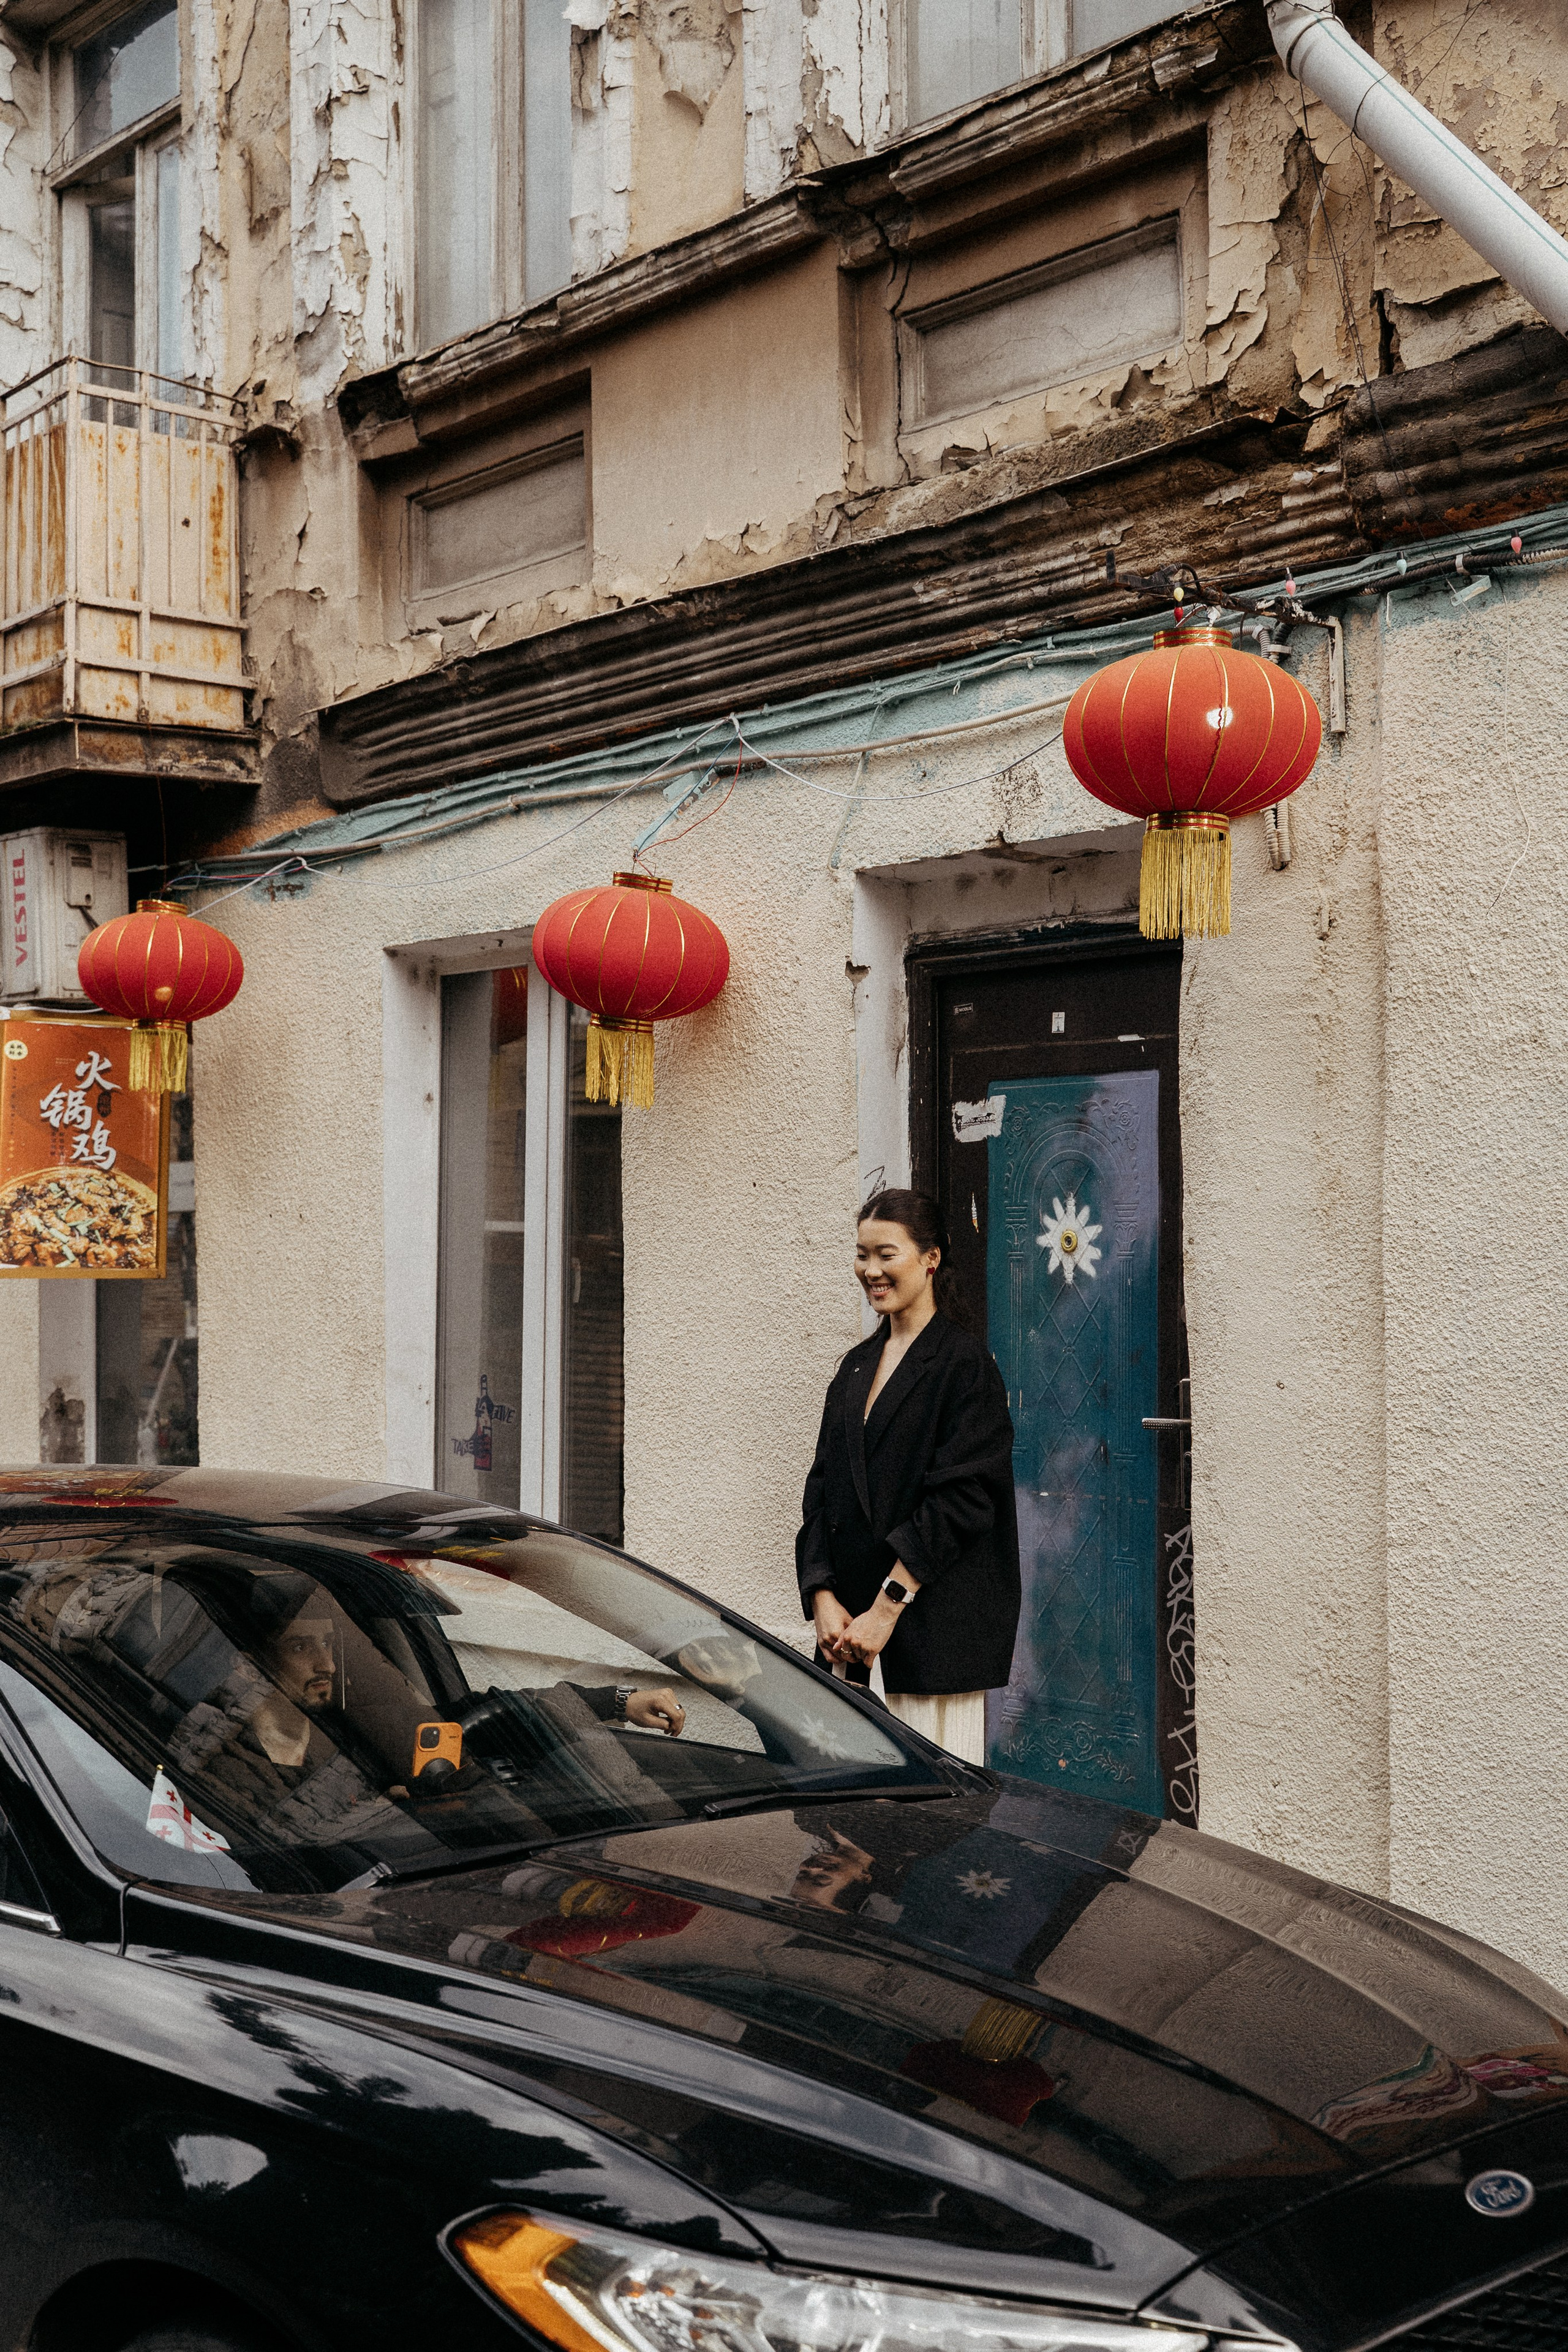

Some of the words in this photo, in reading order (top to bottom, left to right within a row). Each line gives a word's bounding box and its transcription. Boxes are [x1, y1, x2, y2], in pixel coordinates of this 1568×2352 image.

[13, 848, 28, 968] VESTEL
[39, 1050, 123, 1170] 火锅鸡
[1480, 2179, 1522, 2208] Ford
